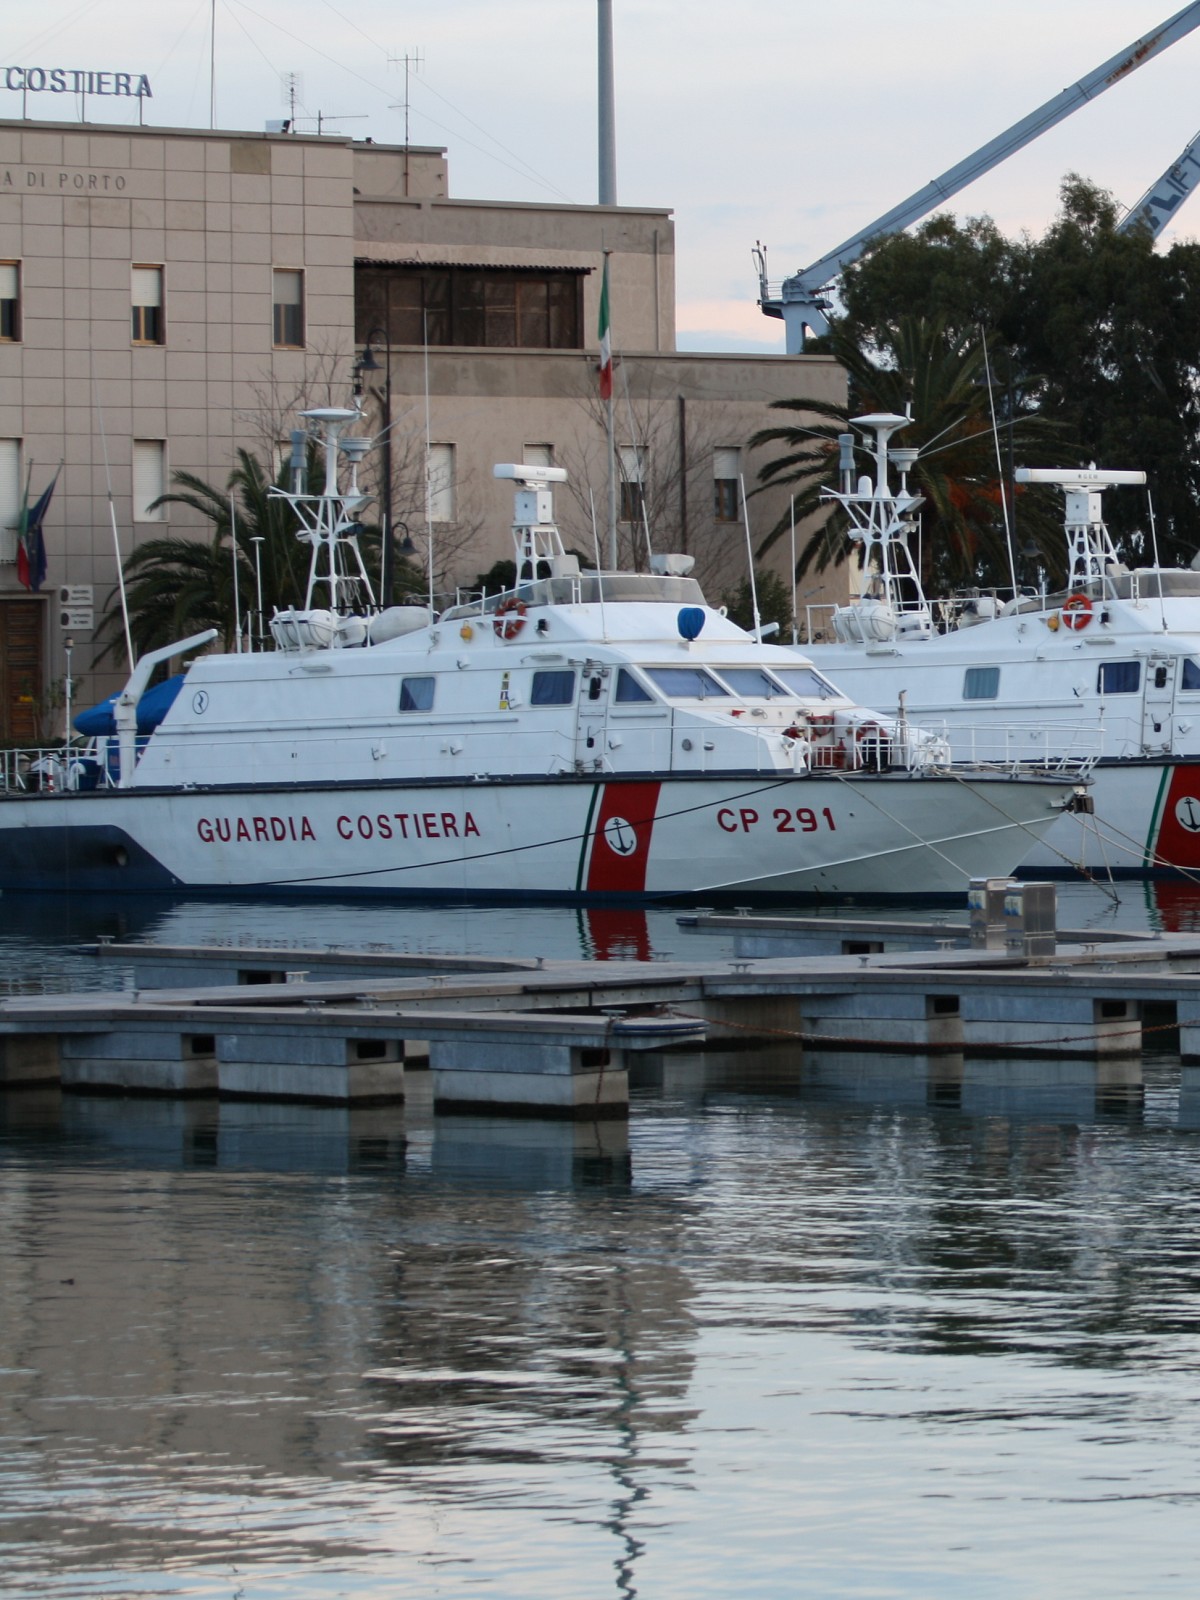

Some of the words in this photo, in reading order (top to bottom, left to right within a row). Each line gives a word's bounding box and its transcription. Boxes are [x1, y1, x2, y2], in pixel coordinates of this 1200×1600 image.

[6, 66, 153, 98] COSTIERA
[27, 171, 45, 187] DI
[59, 173, 126, 191] PORTO
[197, 816, 317, 843] GUARDIA
[336, 811, 481, 840] COSTIERA
[717, 808, 759, 833] CP
[772, 807, 836, 833] 291
